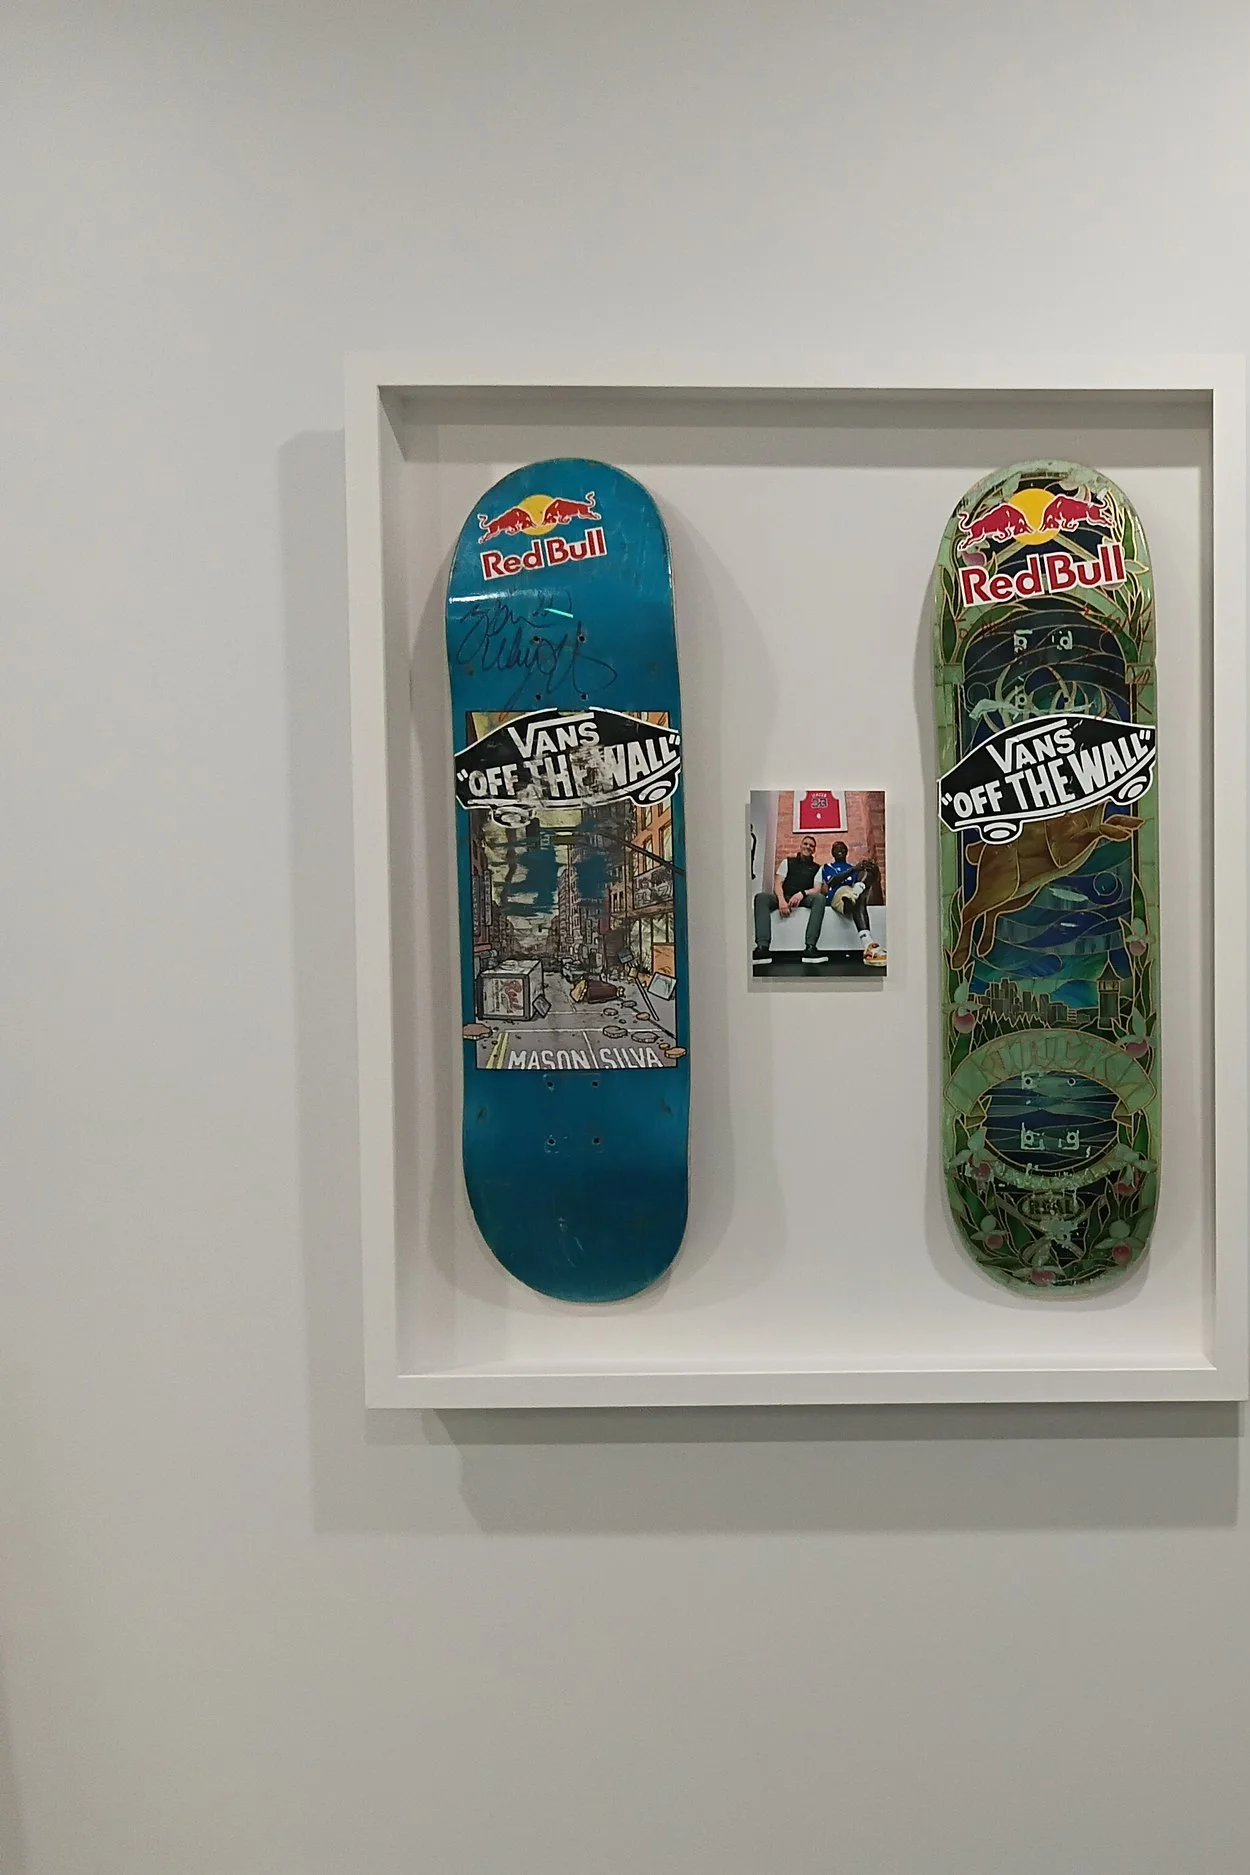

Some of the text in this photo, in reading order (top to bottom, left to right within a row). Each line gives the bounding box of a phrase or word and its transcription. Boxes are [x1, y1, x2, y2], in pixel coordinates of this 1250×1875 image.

[481, 527, 607, 580] Red Bull
[959, 543, 1127, 607] Red Bull
[508, 712, 600, 759] VANS
[986, 719, 1076, 774] VANS
[1005, 758, 1076, 811] THE
[508, 1046, 664, 1070] MASON SILVA
